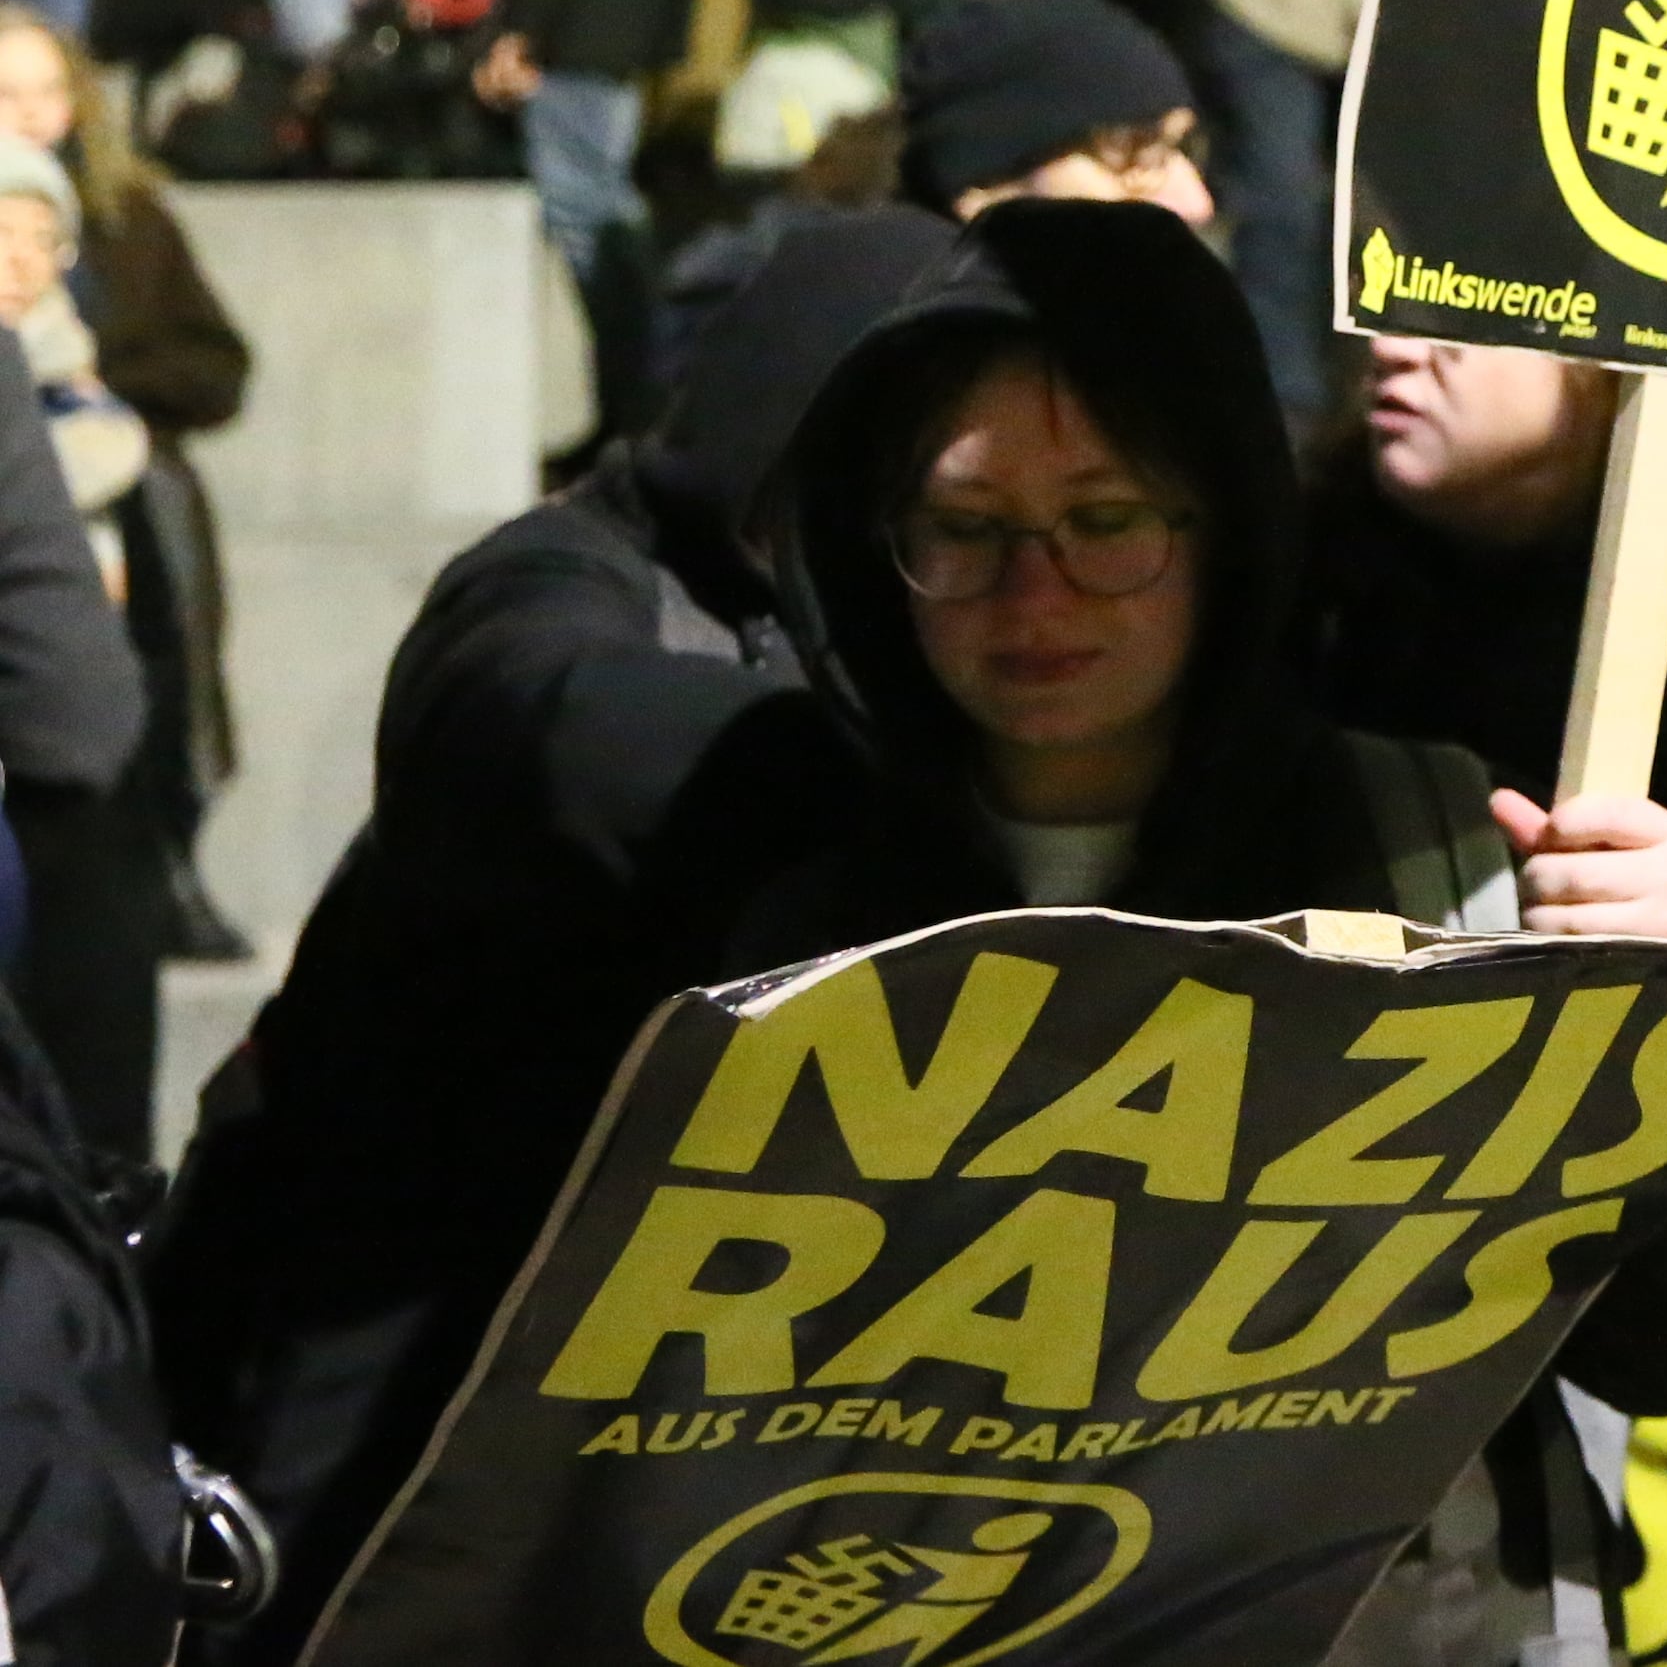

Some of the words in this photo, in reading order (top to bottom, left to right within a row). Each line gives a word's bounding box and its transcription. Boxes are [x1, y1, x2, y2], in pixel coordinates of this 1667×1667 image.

[1392, 254, 1597, 326] Linkswende
[538, 1185, 1623, 1410] RAUS
[578, 1407, 748, 1457] AUS
[755, 1397, 944, 1449] DEM
[946, 1384, 1418, 1464] PARLAMENT
